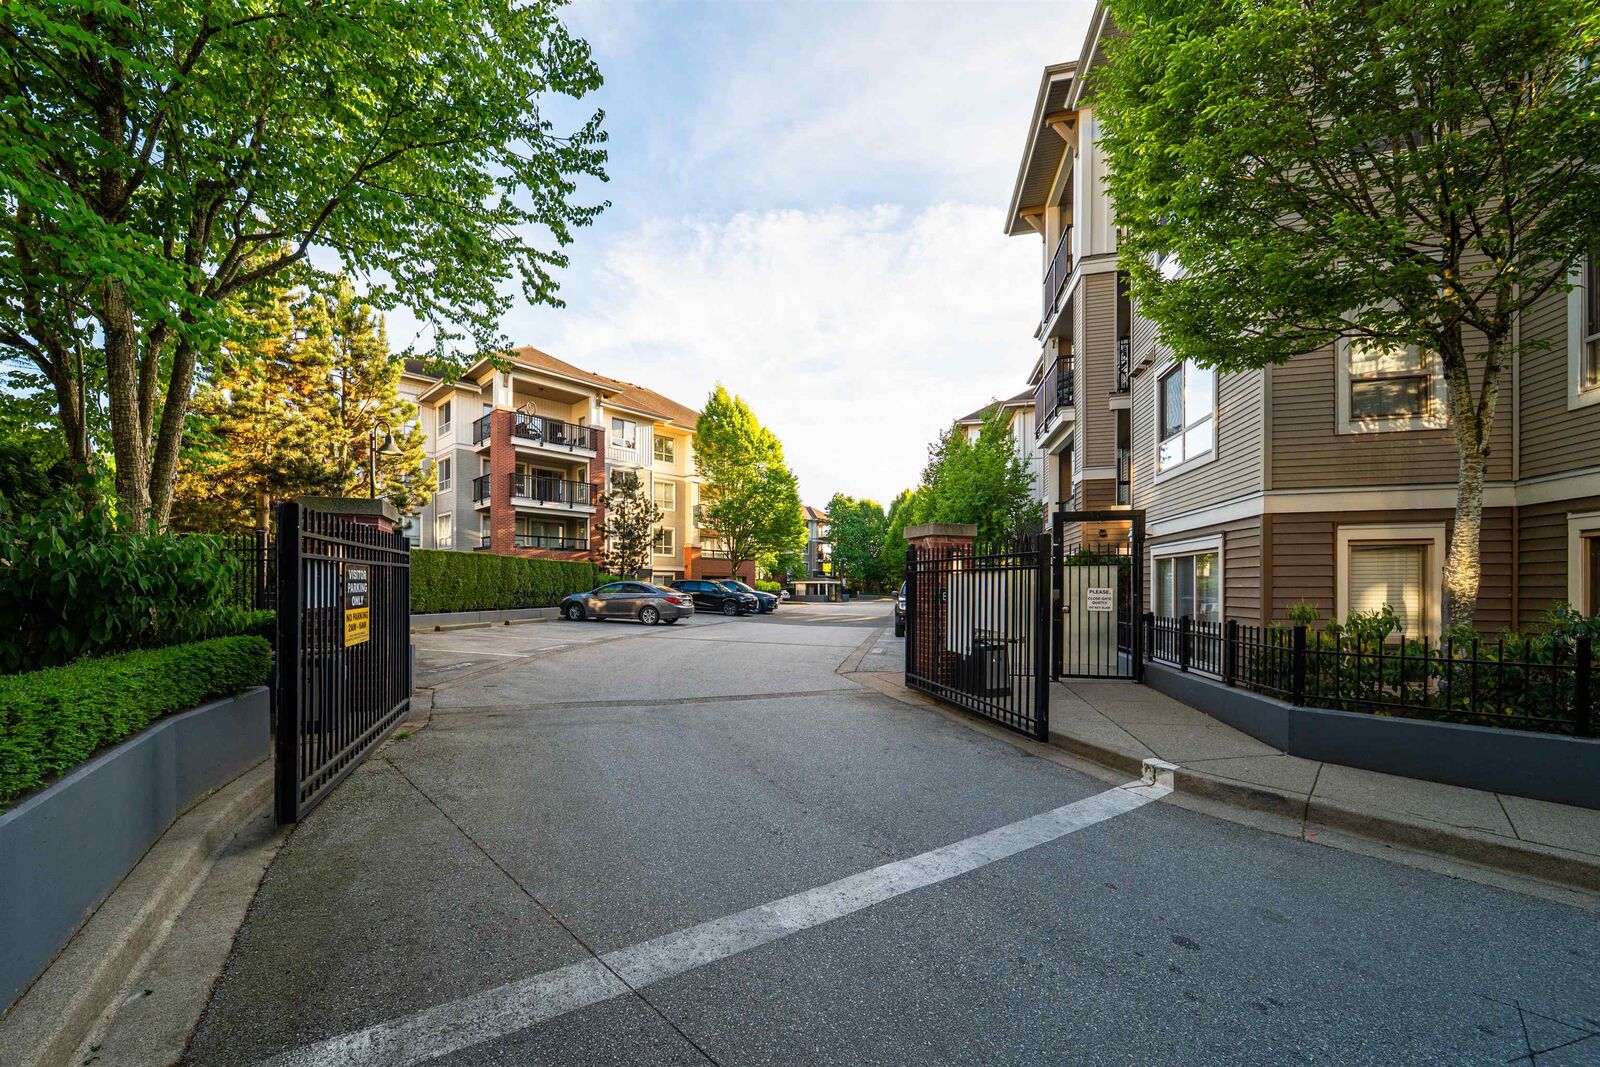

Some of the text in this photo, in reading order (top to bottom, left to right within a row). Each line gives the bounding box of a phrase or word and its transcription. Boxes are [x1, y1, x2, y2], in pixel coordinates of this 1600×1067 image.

[349, 570, 366, 580] VISITOR
[348, 583, 367, 593] PARKING
[352, 596, 364, 607] ONLY
[346, 611, 368, 622] NO PARKING
